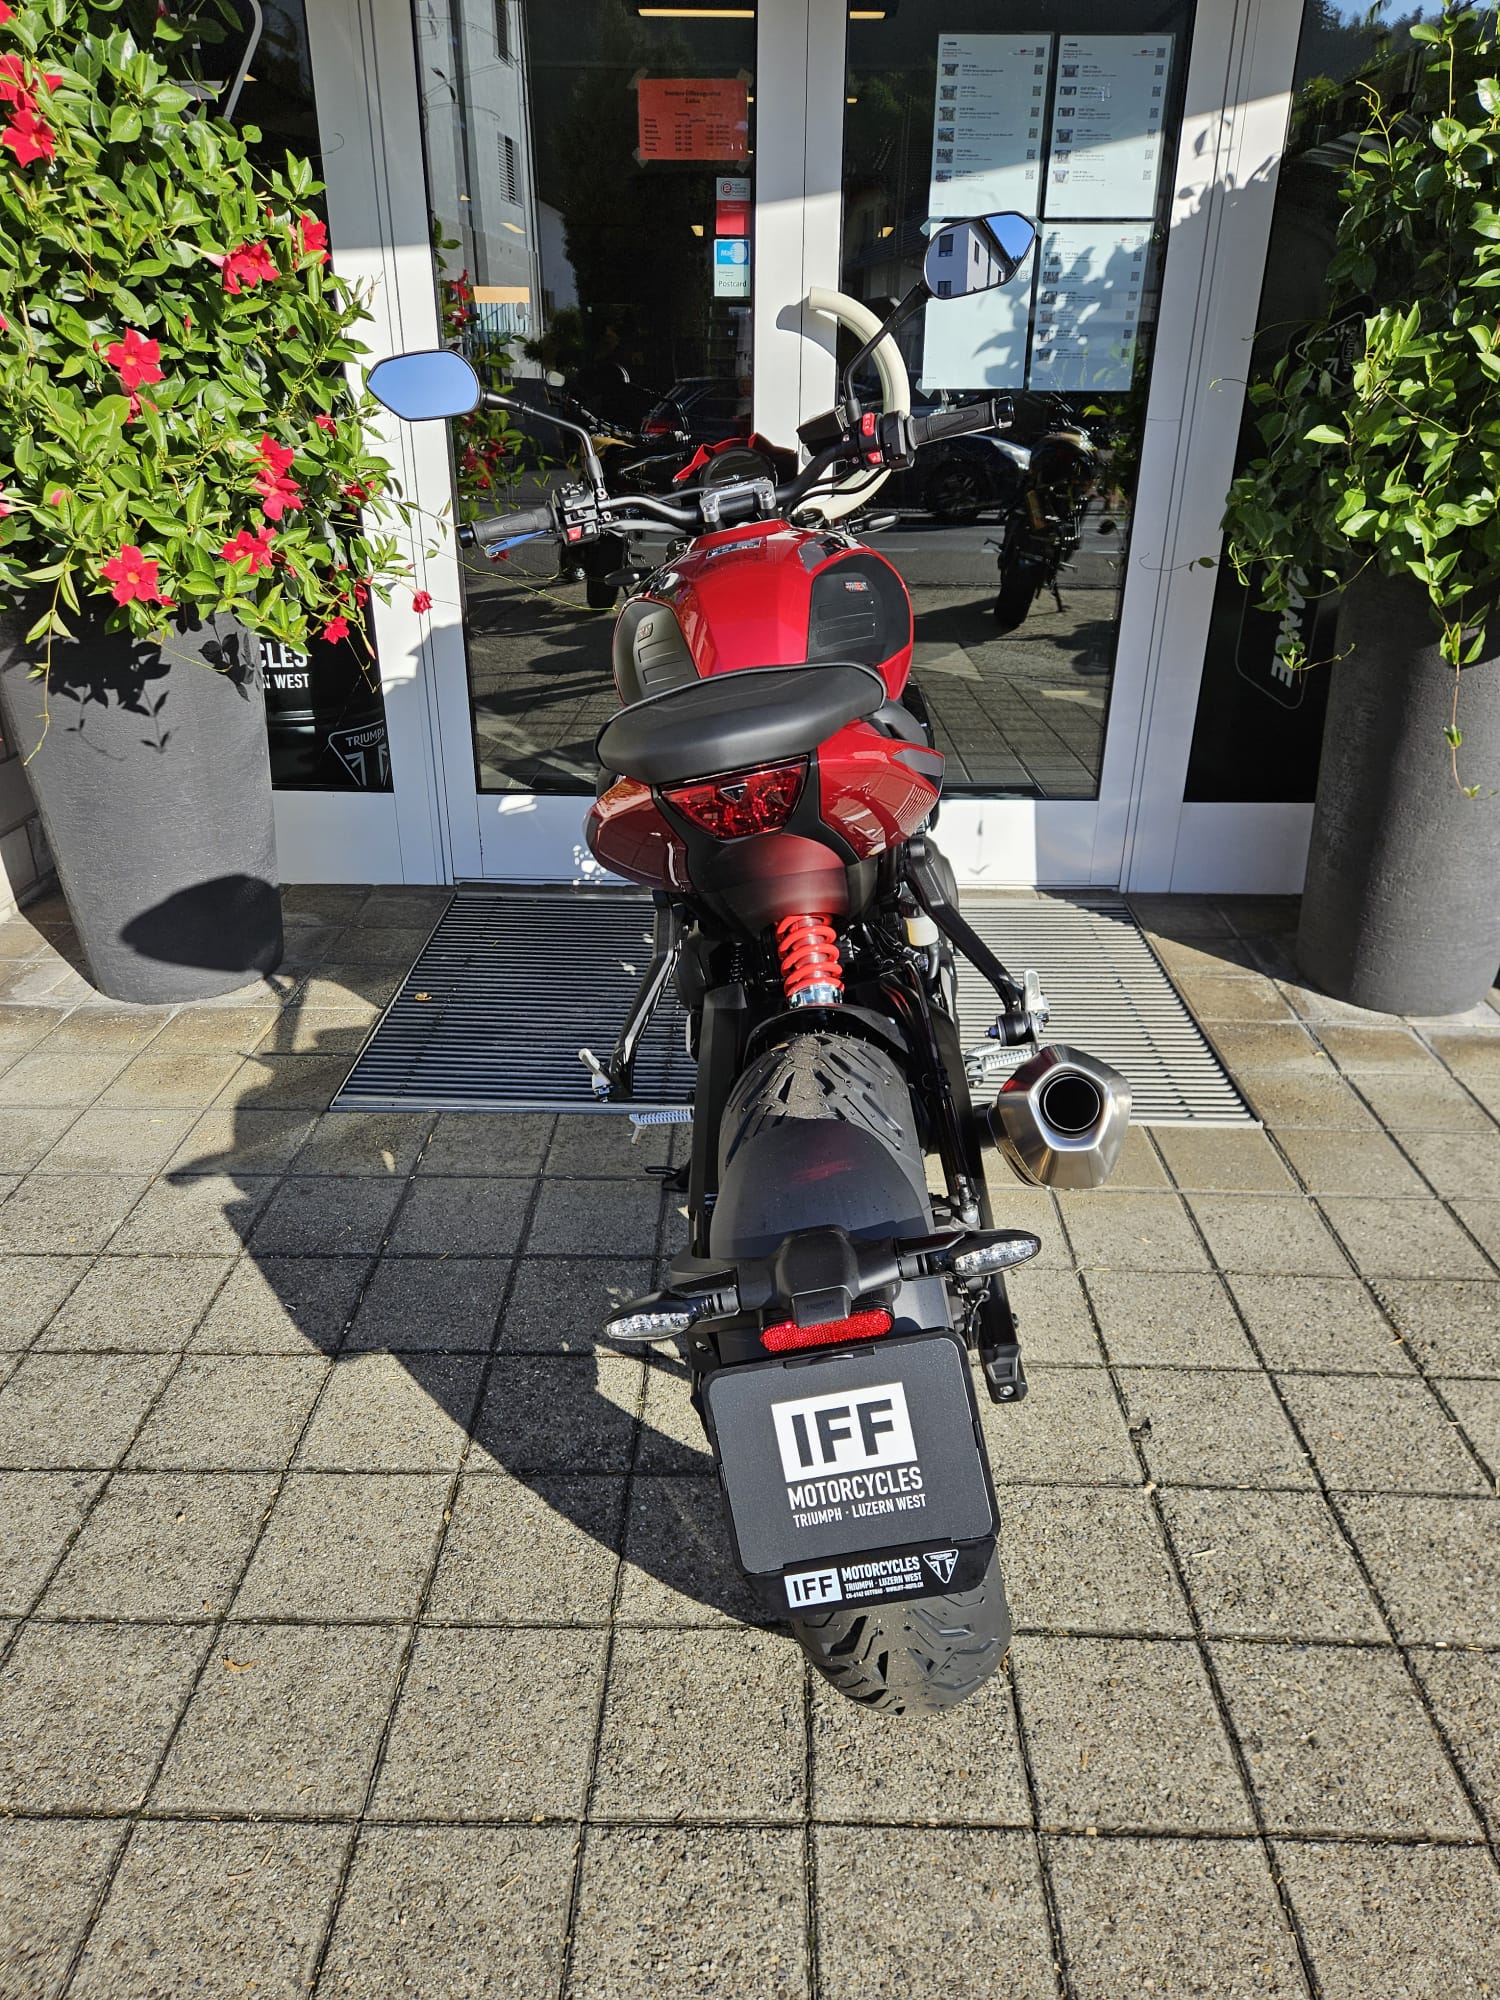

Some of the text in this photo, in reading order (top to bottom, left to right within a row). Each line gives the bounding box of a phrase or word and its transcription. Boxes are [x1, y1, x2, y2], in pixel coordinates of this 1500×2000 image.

[718, 280, 746, 288] Postcard
[274, 673, 310, 689] WEST
[791, 1399, 894, 1468] IFF
[787, 1467, 923, 1511] MOTORCYCLES
[793, 1494, 926, 1529] TRIUMPH LUZERN WEST
[841, 1556, 920, 1581] MOTORCYCLES
[792, 1575, 833, 1602] IFF
[844, 1572, 922, 1592] TRIUMPH LUZERN WEST
